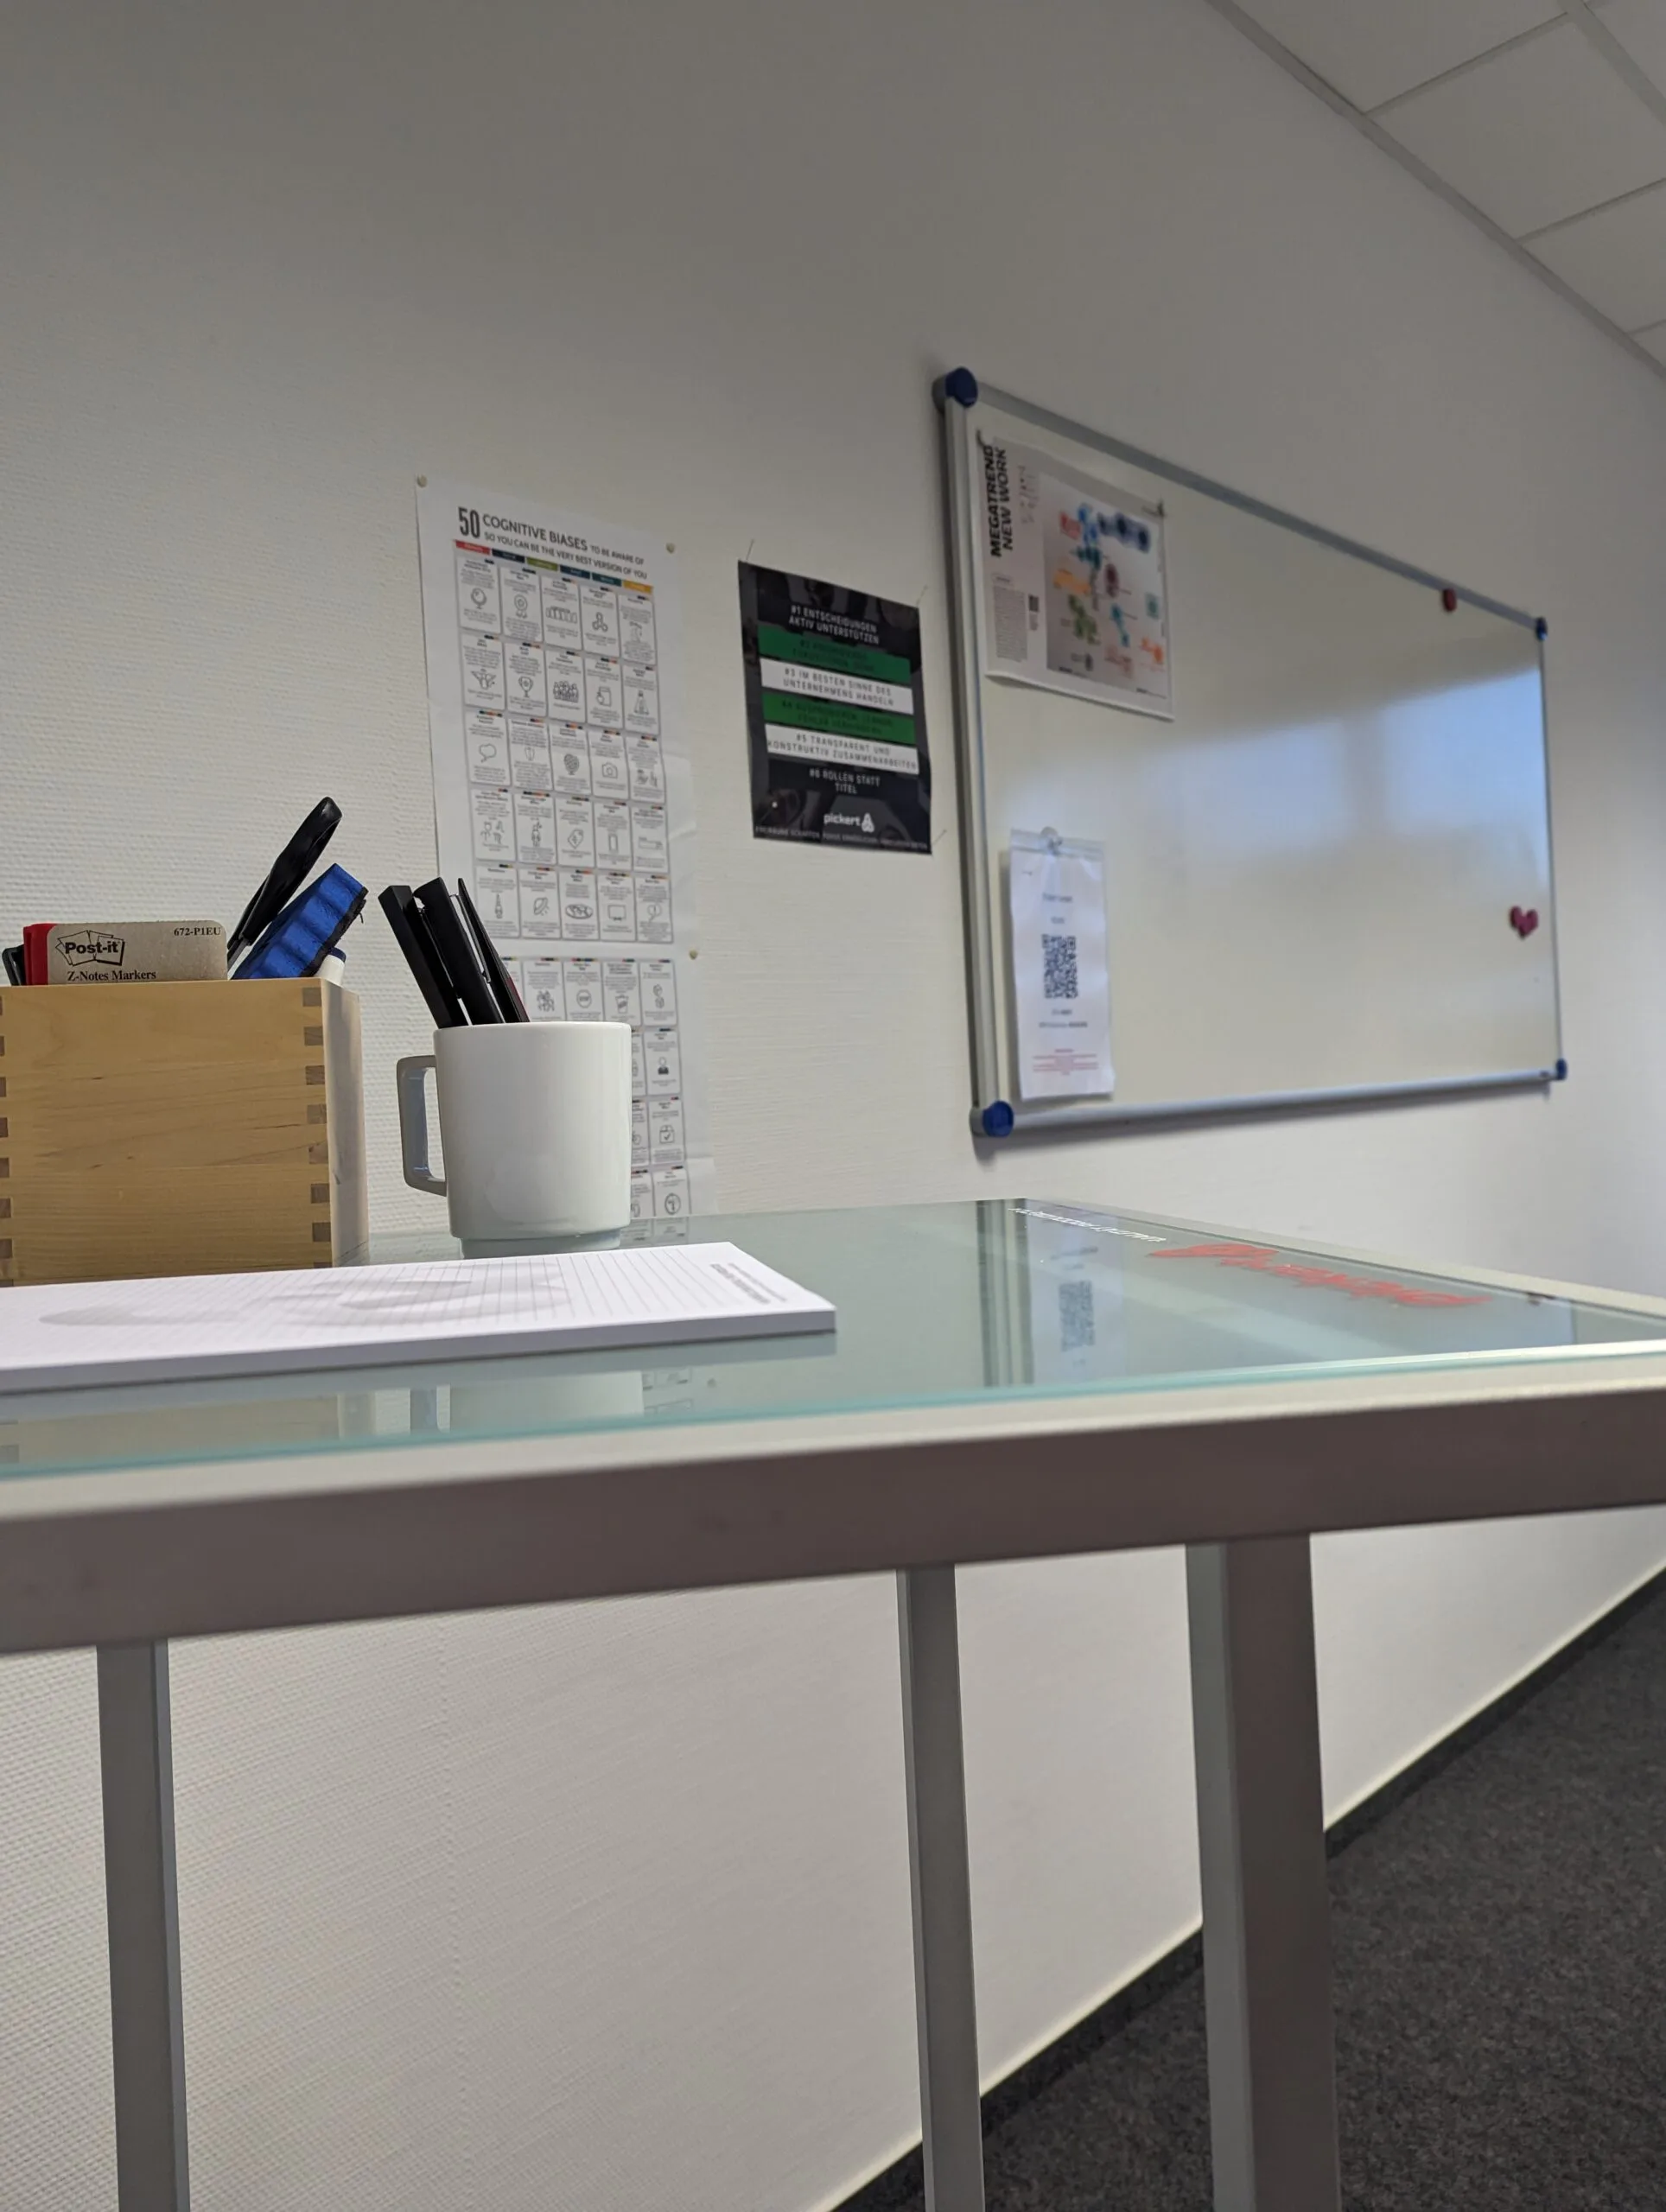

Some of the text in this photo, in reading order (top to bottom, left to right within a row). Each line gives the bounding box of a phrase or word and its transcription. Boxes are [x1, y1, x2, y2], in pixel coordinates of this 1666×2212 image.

[983, 446, 1002, 557] MEGATREND
[995, 447, 1013, 550] NEW WORK
[458, 506, 645, 566] 50 COGNITIVE BIASES TO BE AWARE OF
[484, 531, 495, 542] SO
[497, 535, 513, 546] YOU
[514, 538, 530, 550] CAN
[531, 543, 540, 553] BE
[541, 545, 556, 557] THE
[556, 550, 575, 562] VERY
[575, 555, 592, 566] BEST
[593, 559, 622, 573] VERSION
[622, 566, 633, 575] OF
[633, 569, 648, 580] YOU
[789, 615, 880, 645] AKTIV UNTERSTÜTZEN
[803, 607, 877, 633] ENTSCHEIDUNGEN
[783, 677, 893, 707] UNTERNEHMENS HANDELN
[799, 670, 809, 678] IM
[812, 672, 845, 686] BESTEN
[849, 680, 873, 693] SINNE
[875, 685, 891, 696] DES
[768, 741, 917, 770] KONSTRUKTIV ZUSAMMENARBEITEN
[797, 733, 890, 755] #5 TRANSPARENT UND
[822, 769, 854, 783] ROLLEN
[856, 775, 881, 786] STATT
[835, 783, 857, 794] TITEL
[823, 813, 861, 826] pickert
[174, 926, 221, 937] 672-P1EU
[65, 941, 118, 955] Post-it
[67, 969, 156, 981] Z-Notes Markers
